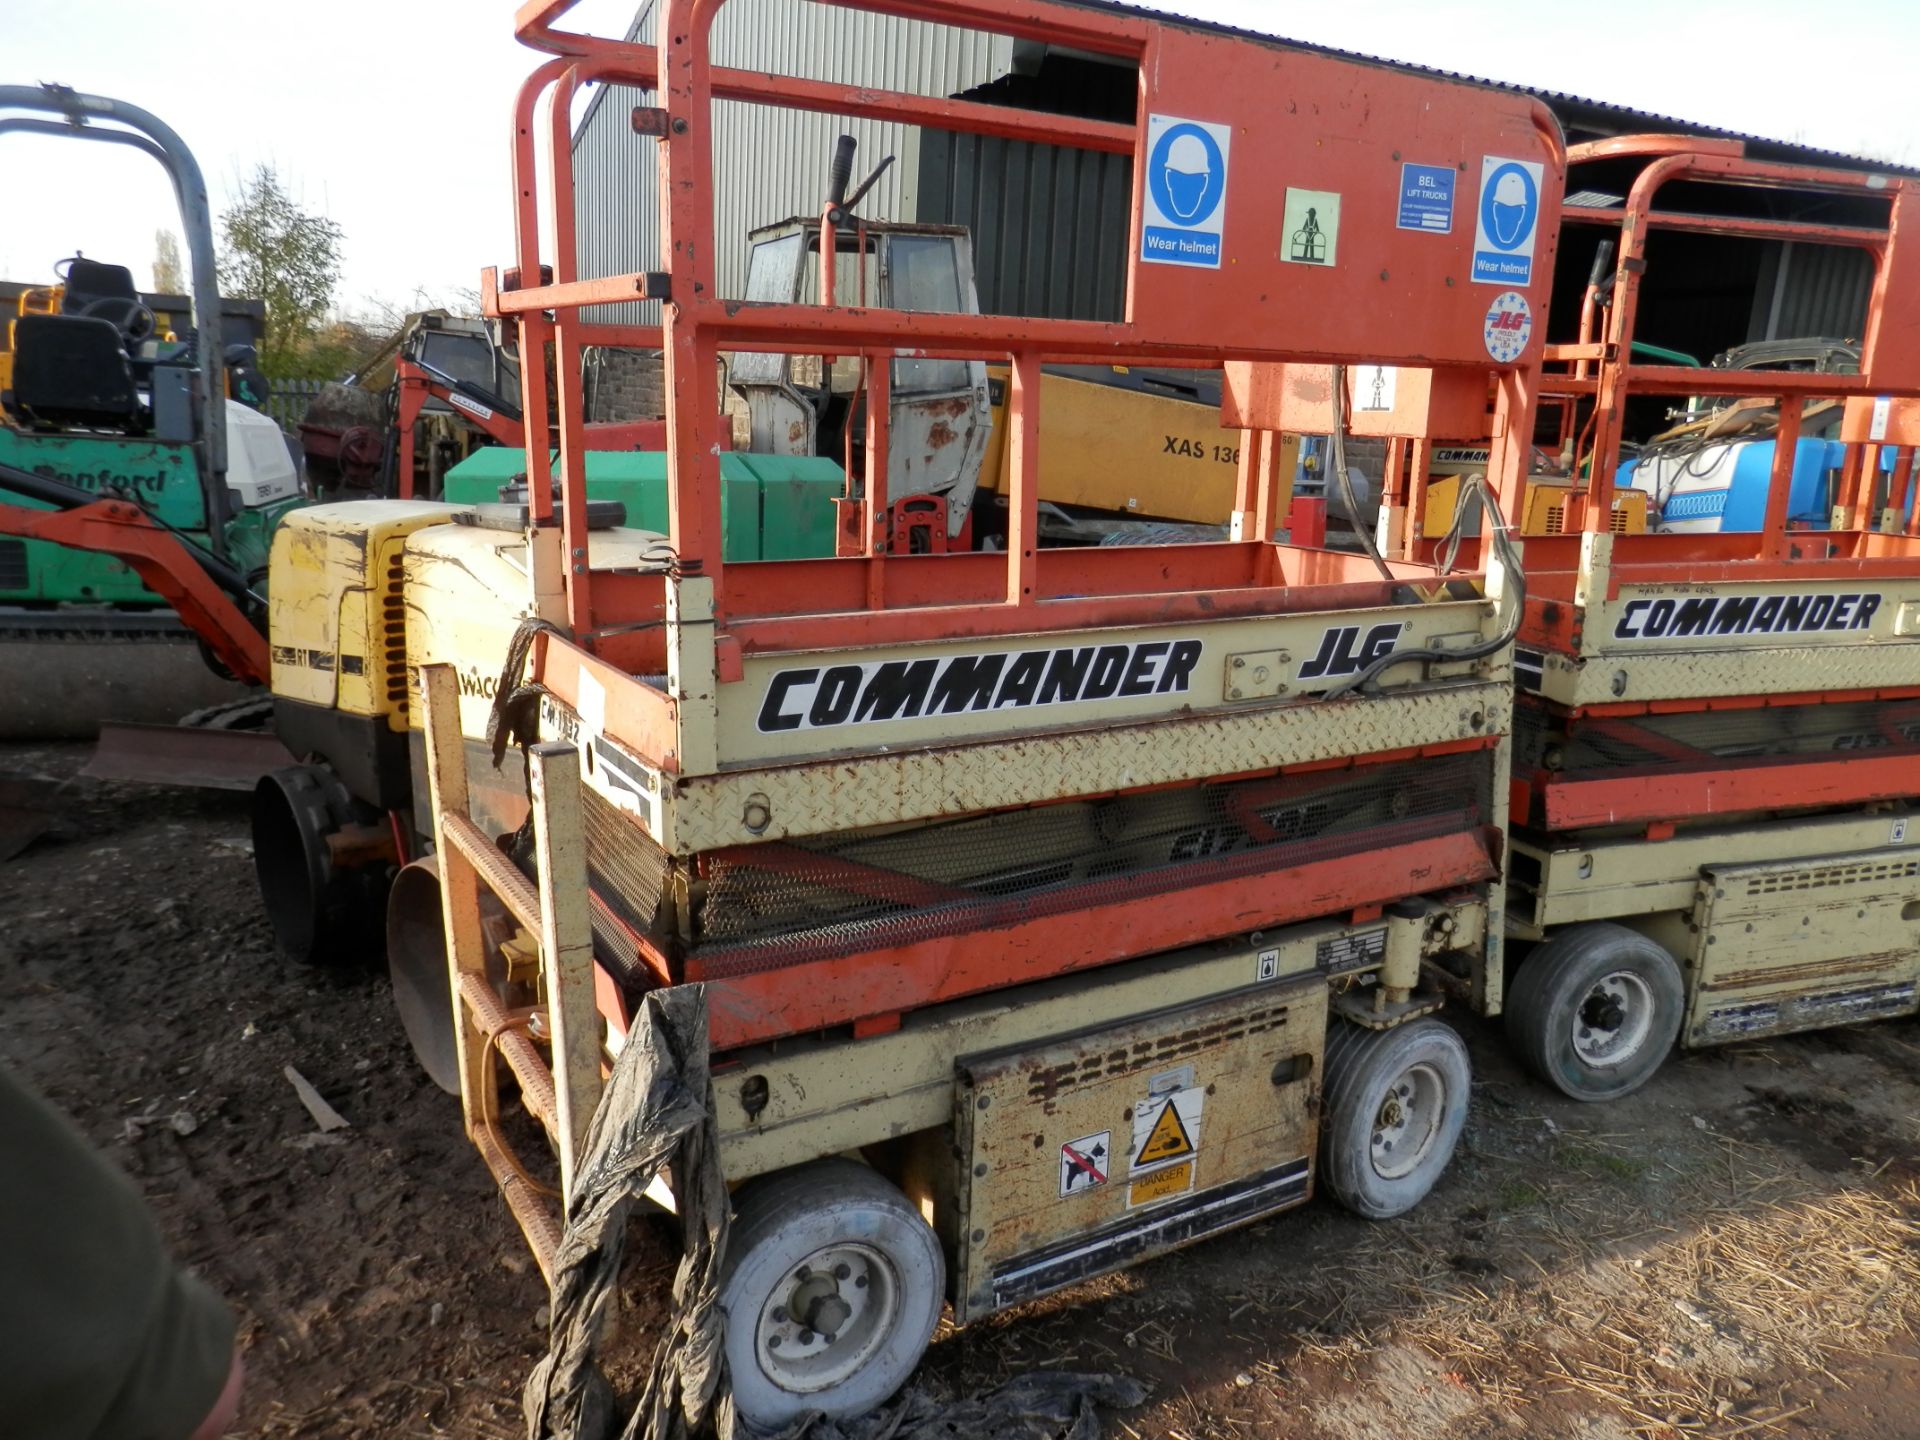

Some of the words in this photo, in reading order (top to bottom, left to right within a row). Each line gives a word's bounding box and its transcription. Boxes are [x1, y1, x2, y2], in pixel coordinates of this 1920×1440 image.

[1418, 176, 1436, 188] BEL
[1407, 189, 1421, 198] LIFT
[1422, 190, 1447, 201] TRUCKS
[1147, 235, 1178, 251] Wear
[1179, 239, 1217, 255] helmet
[1477, 260, 1499, 272] Wear
[1500, 262, 1528, 274] helmet
[1491, 311, 1526, 331] JLG
[1163, 435, 1205, 459] XAS
[1614, 593, 1882, 638] COMMANDER
[1297, 623, 1403, 679] JLG
[757, 640, 1202, 732] COMMANDER
[1139, 1167, 1184, 1188] DANGER
